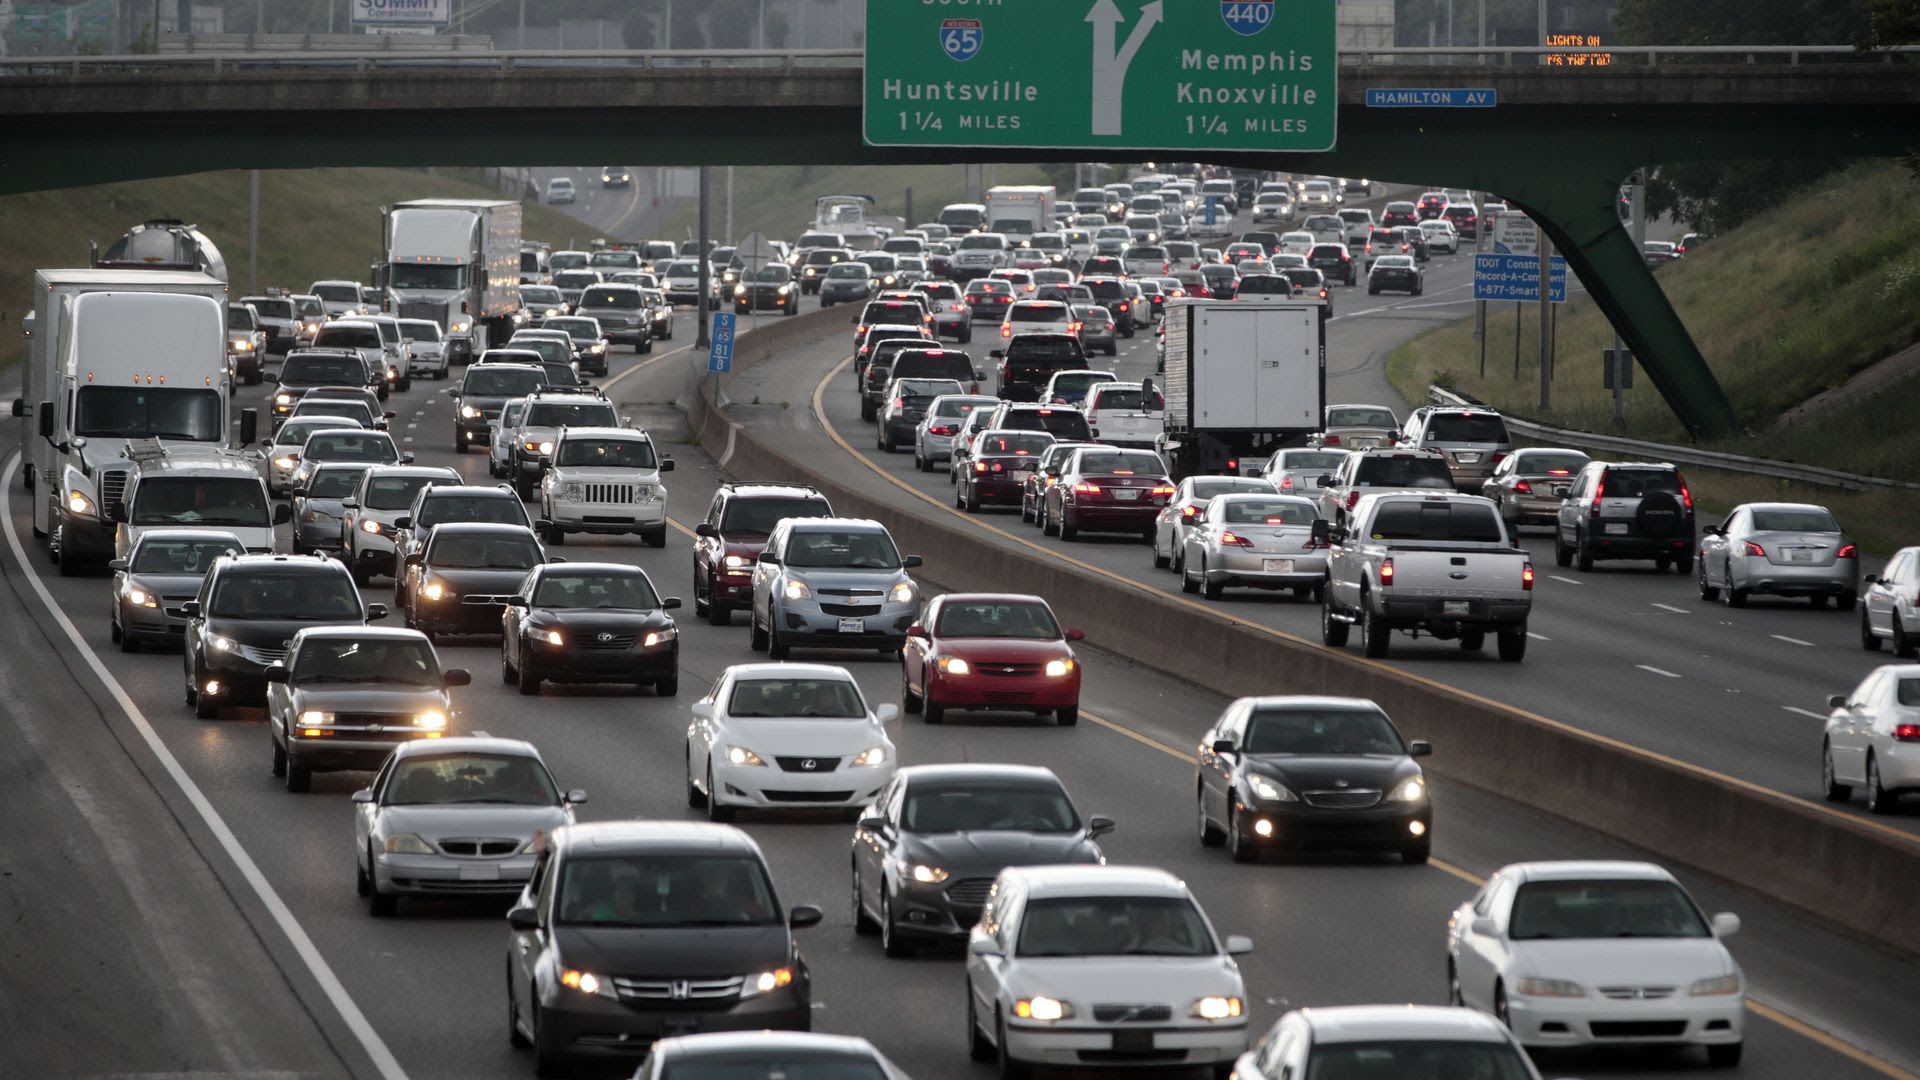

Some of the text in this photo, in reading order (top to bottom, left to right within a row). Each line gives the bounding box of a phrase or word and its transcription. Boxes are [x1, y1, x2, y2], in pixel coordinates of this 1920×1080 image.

[1225, 3, 1270, 24] 440
[945, 30, 978, 53] 65
[1546, 35, 1600, 46] LIGHTS ON
[1182, 49, 1312, 75] Memphis
[883, 79, 1038, 101] Huntsville
[1177, 82, 1317, 105] Knoxville
[1375, 92, 1487, 104] HAMILTON AV
[959, 115, 1021, 129] MILES
[1245, 119, 1307, 132] MILES
[1477, 258, 1564, 269] TDOT Construion
[1475, 271, 1565, 283] Record-A-Coment
[1478, 285, 1561, 298] 1-877-Smartay
[721, 315, 728, 326] S
[715, 344, 727, 356] 81
[717, 359, 723, 370] 8
